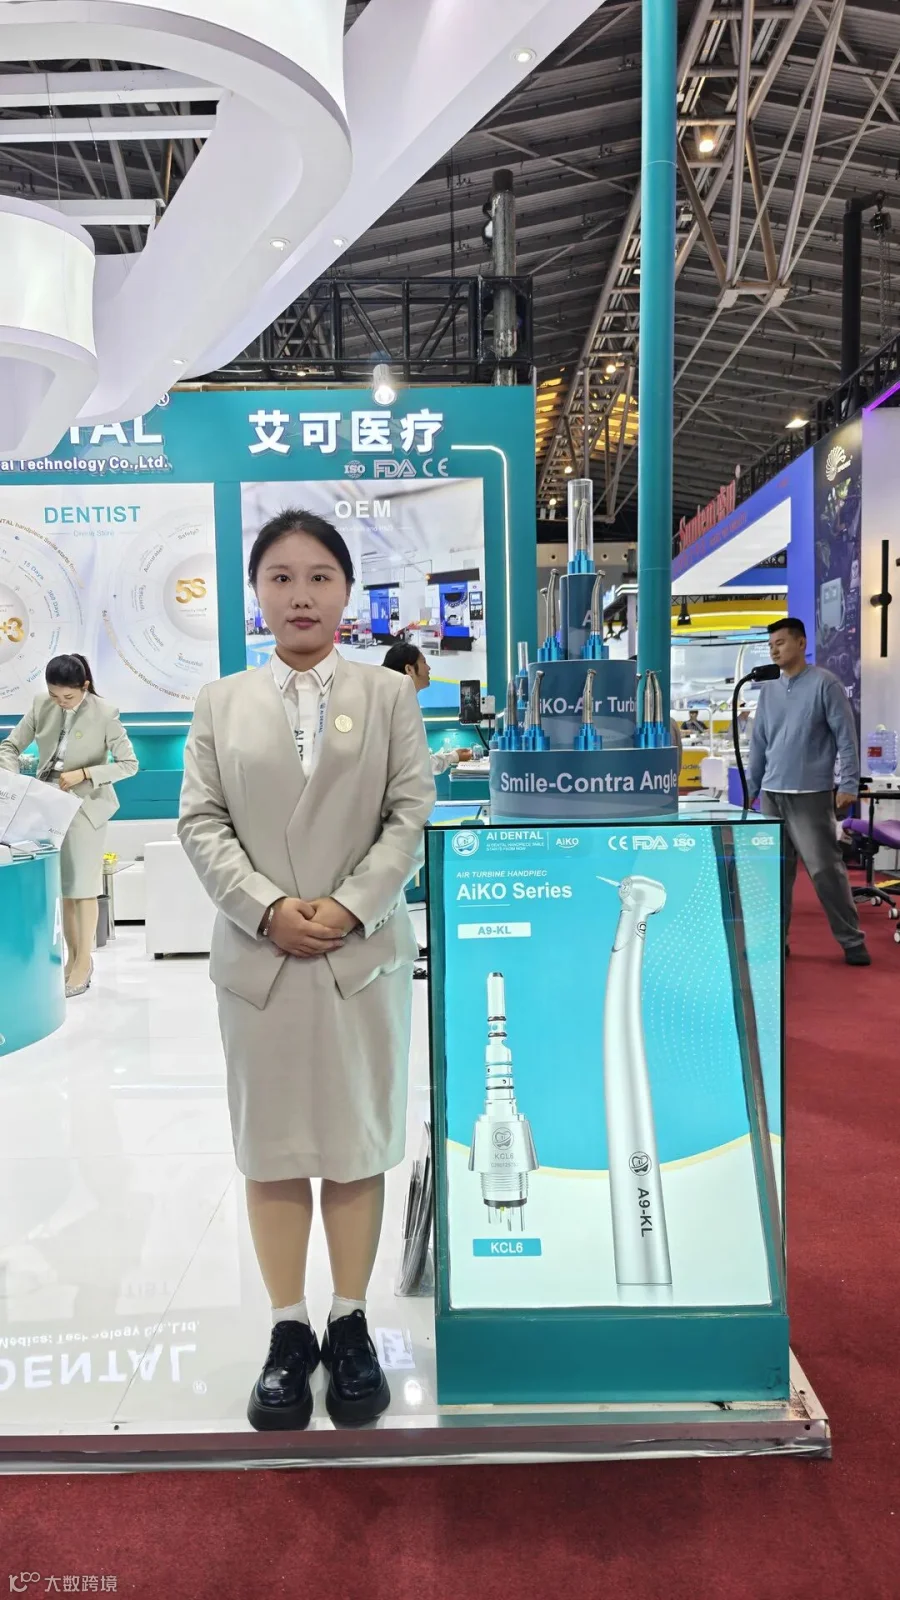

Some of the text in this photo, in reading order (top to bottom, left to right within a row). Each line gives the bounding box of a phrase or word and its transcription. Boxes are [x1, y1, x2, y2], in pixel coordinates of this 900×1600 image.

[248, 408, 444, 454] 艾可医疗
[20, 457, 105, 471] Technology
[109, 455, 169, 470] Co.,Ltd.
[344, 457, 449, 478] ISO FDA CE
[44, 506, 141, 524] DENTIST
[334, 499, 391, 519] OEM
[30, 565, 45, 581] Days
[175, 577, 207, 604] 5S
[500, 768, 677, 794] Smile-Contra Angle
[486, 830, 544, 840] AI DENTAL
[608, 836, 696, 850] CE FDA ISO
[456, 871, 470, 879] AIR
[507, 870, 547, 878] HANDPIEC
[456, 882, 573, 900] AiKO Series
[477, 925, 512, 935] A9-KL
[494, 1152, 514, 1160] KCL6
[637, 1187, 653, 1238] A9-KL
[490, 1242, 523, 1254] KCL6
